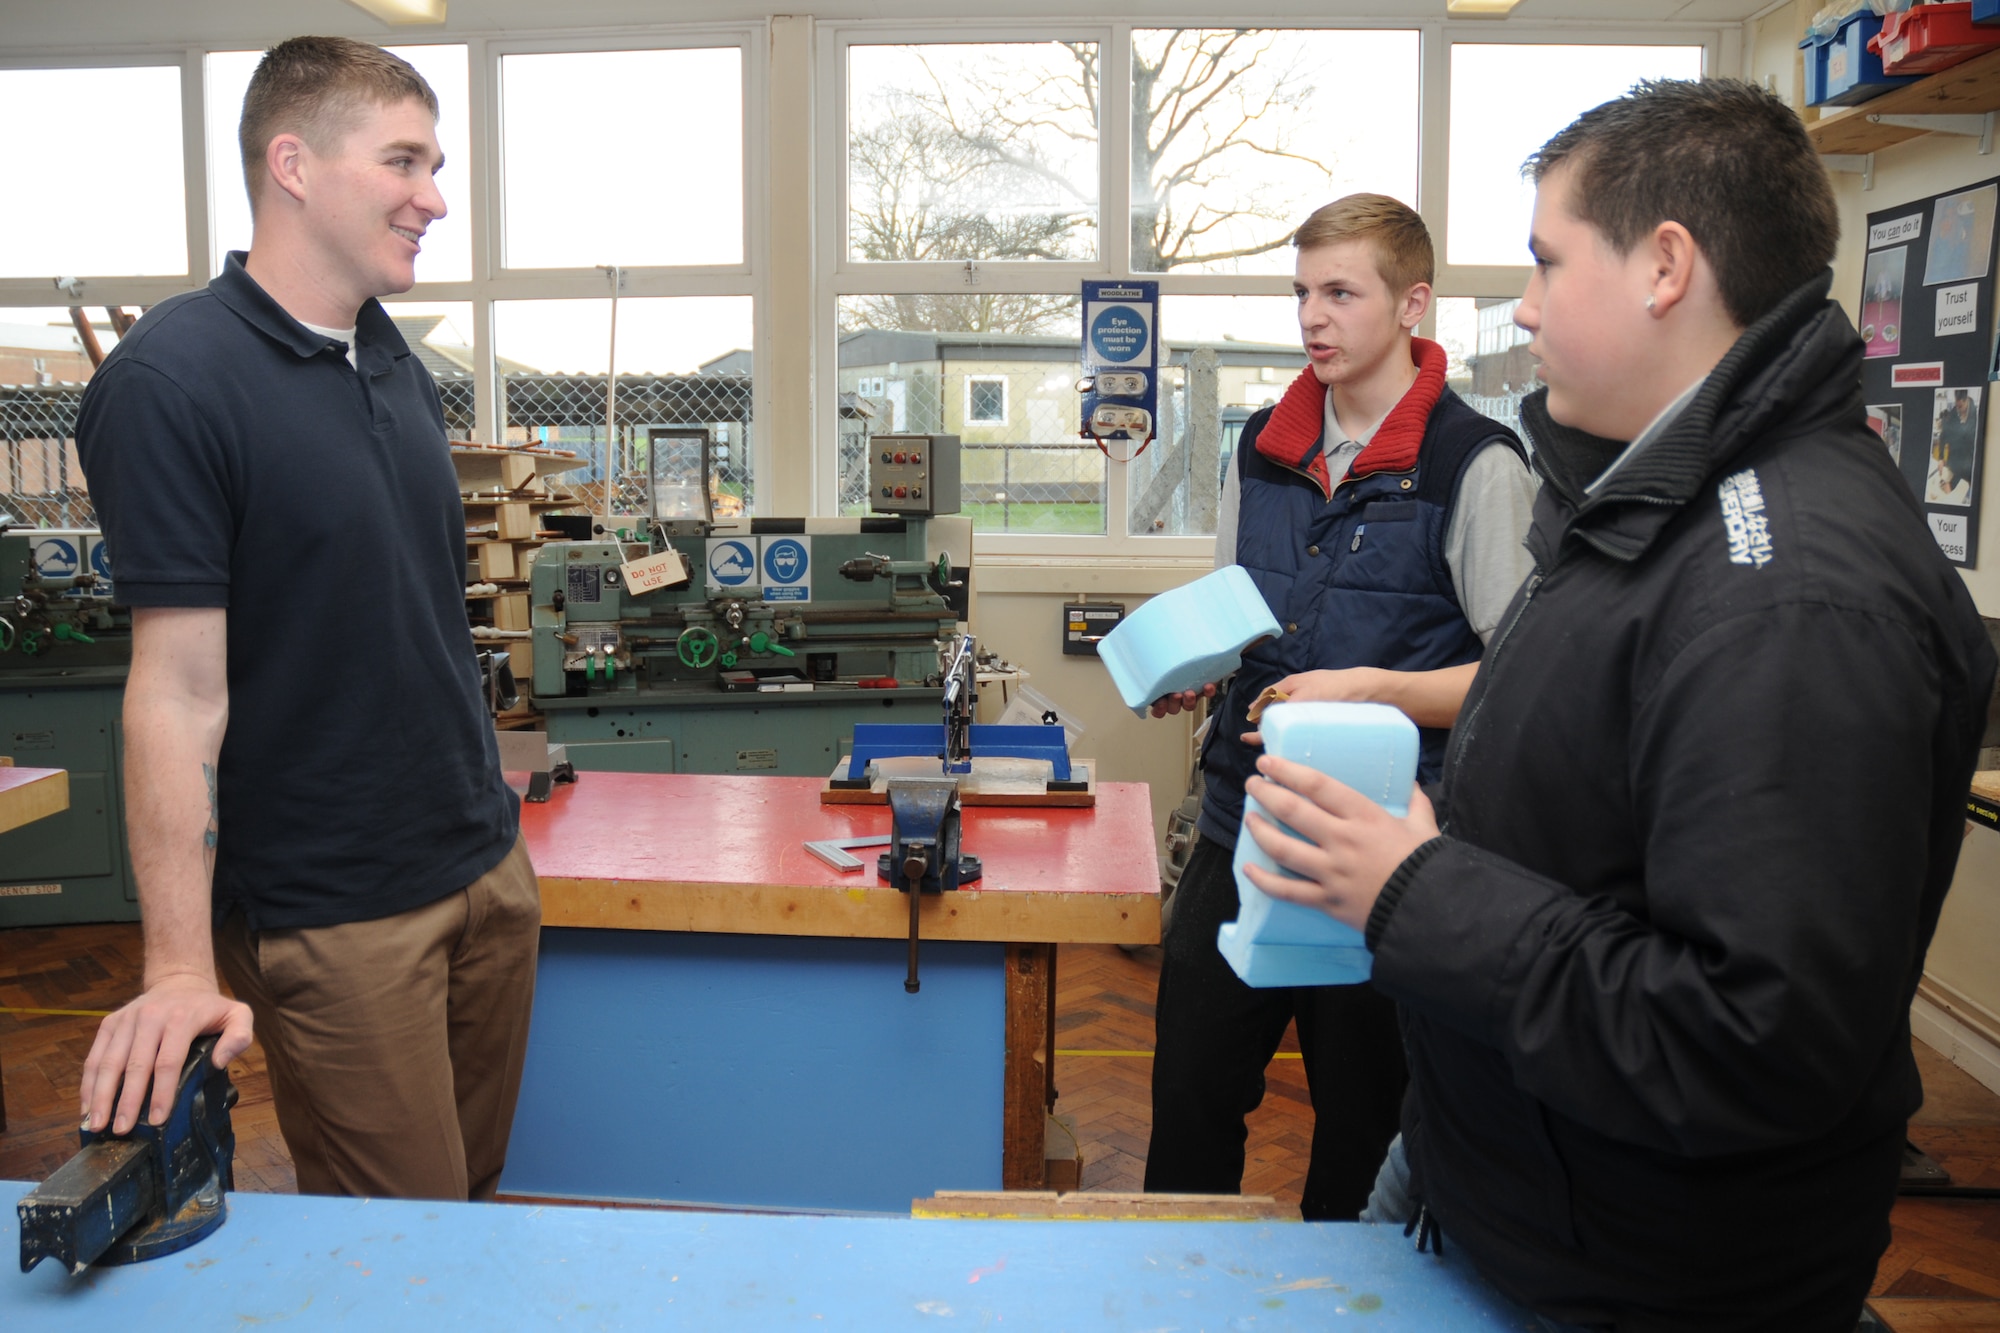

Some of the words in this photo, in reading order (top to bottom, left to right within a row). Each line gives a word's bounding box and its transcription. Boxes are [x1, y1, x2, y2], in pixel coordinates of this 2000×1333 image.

[1872, 229, 1887, 240] You
[1887, 226, 1901, 240] can
[1902, 221, 1912, 233] do
[1913, 218, 1919, 230] it
[1945, 290, 1968, 305] Trust
[1111, 317, 1128, 326] Eye
[1938, 310, 1973, 331] yourself
[1097, 326, 1142, 335] protection
[1102, 336, 1124, 344] must
[1125, 335, 1137, 343] be
[1936, 519, 1958, 533] Your
[1940, 543, 1964, 556] ccess
[631, 569, 645, 579] DO
[648, 562, 667, 575] NOT
[642, 576, 664, 587] USE
[0, 886, 30, 896] GENCY
[36, 884, 58, 894] STOP
